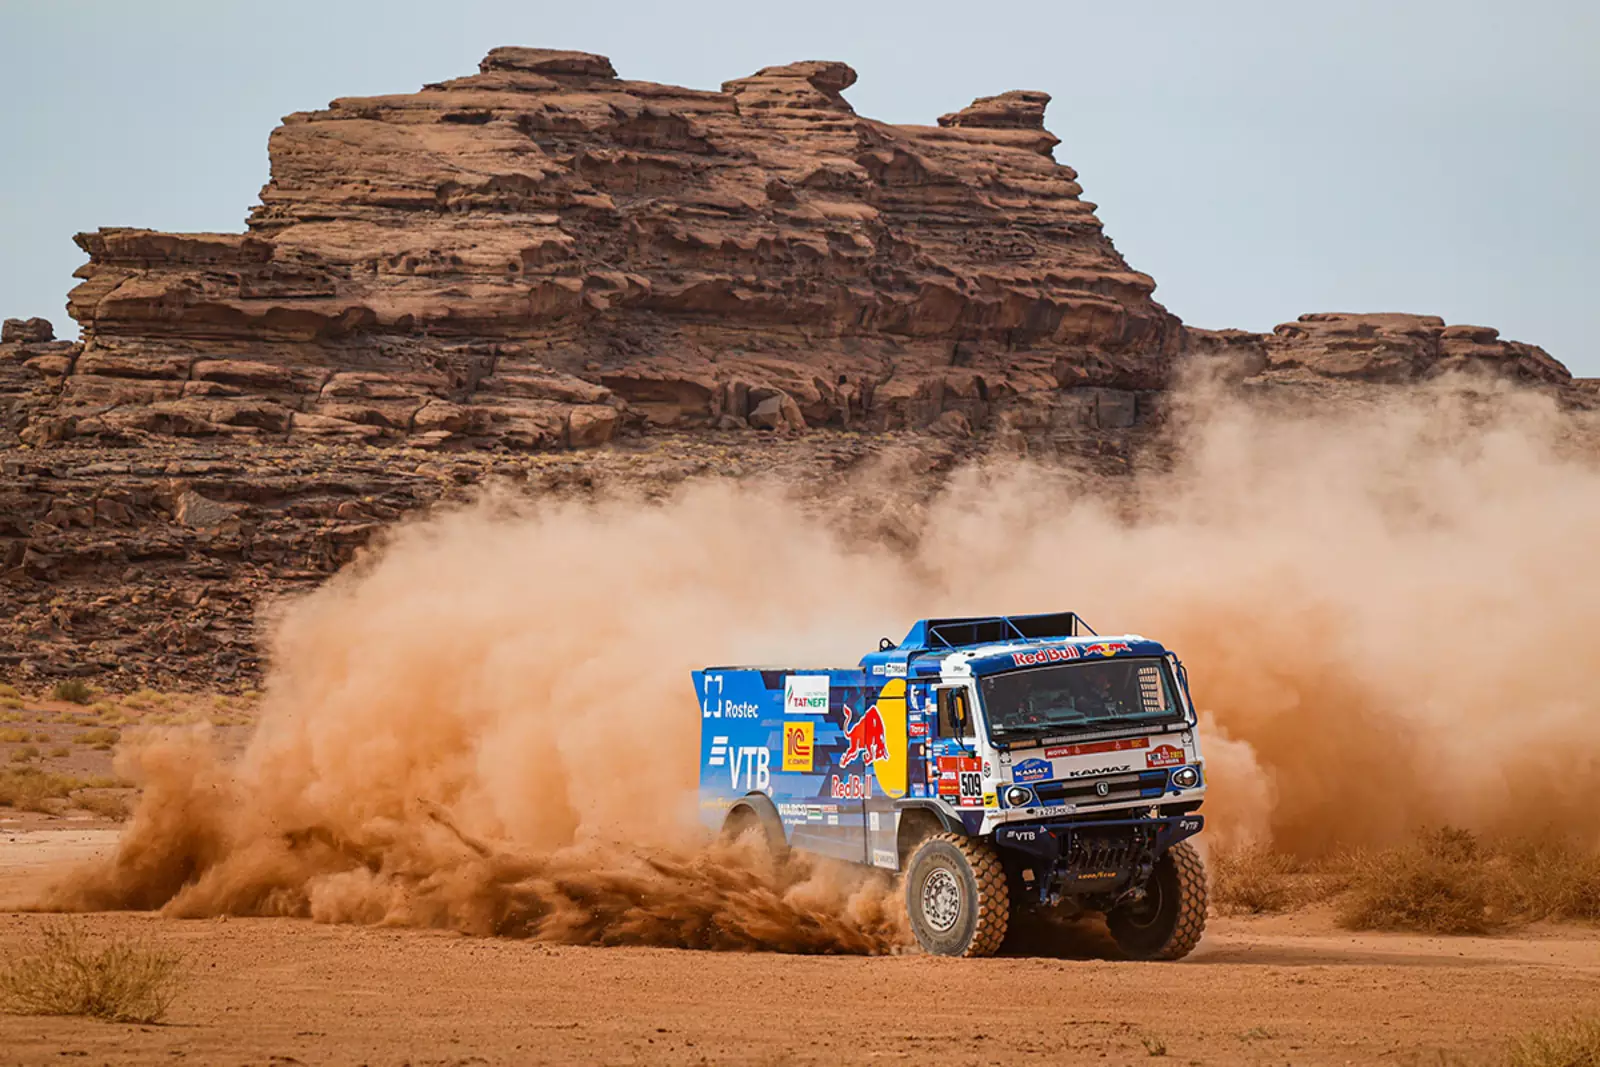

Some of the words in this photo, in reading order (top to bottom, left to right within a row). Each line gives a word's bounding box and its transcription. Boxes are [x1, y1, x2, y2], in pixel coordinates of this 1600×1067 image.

[1012, 649, 1047, 667] Red
[1047, 646, 1080, 662] Bull
[725, 699, 759, 718] Rostec
[794, 697, 827, 708] TATNEFT
[1046, 748, 1069, 757] MOTUL
[728, 746, 770, 790] VTB
[1015, 767, 1049, 777] KAMAZ
[1069, 765, 1130, 777] KAMAZ
[831, 773, 853, 799] Red
[853, 773, 872, 800] Bull
[961, 773, 983, 797] 509
[1015, 831, 1036, 841] VTB
